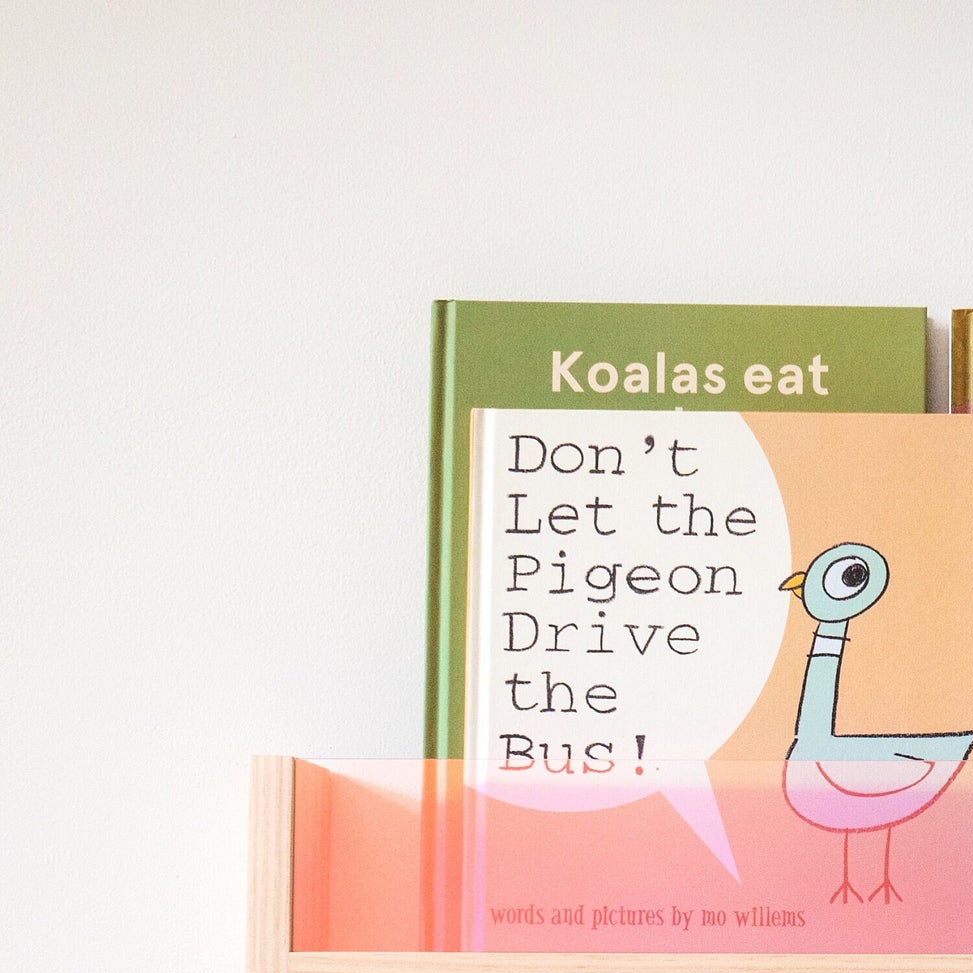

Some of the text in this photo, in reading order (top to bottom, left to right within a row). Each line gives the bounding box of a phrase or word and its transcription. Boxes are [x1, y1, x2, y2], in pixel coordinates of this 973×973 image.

[551, 350, 829, 396] Koalas eat
[508, 435, 699, 477] Don't
[504, 493, 757, 537] Let the
[506, 550, 743, 604] Pigeon
[503, 611, 700, 656] Drive
[505, 671, 618, 714] the
[499, 734, 647, 776] Bus!
[490, 904, 806, 931] words and pictures by mo willems
